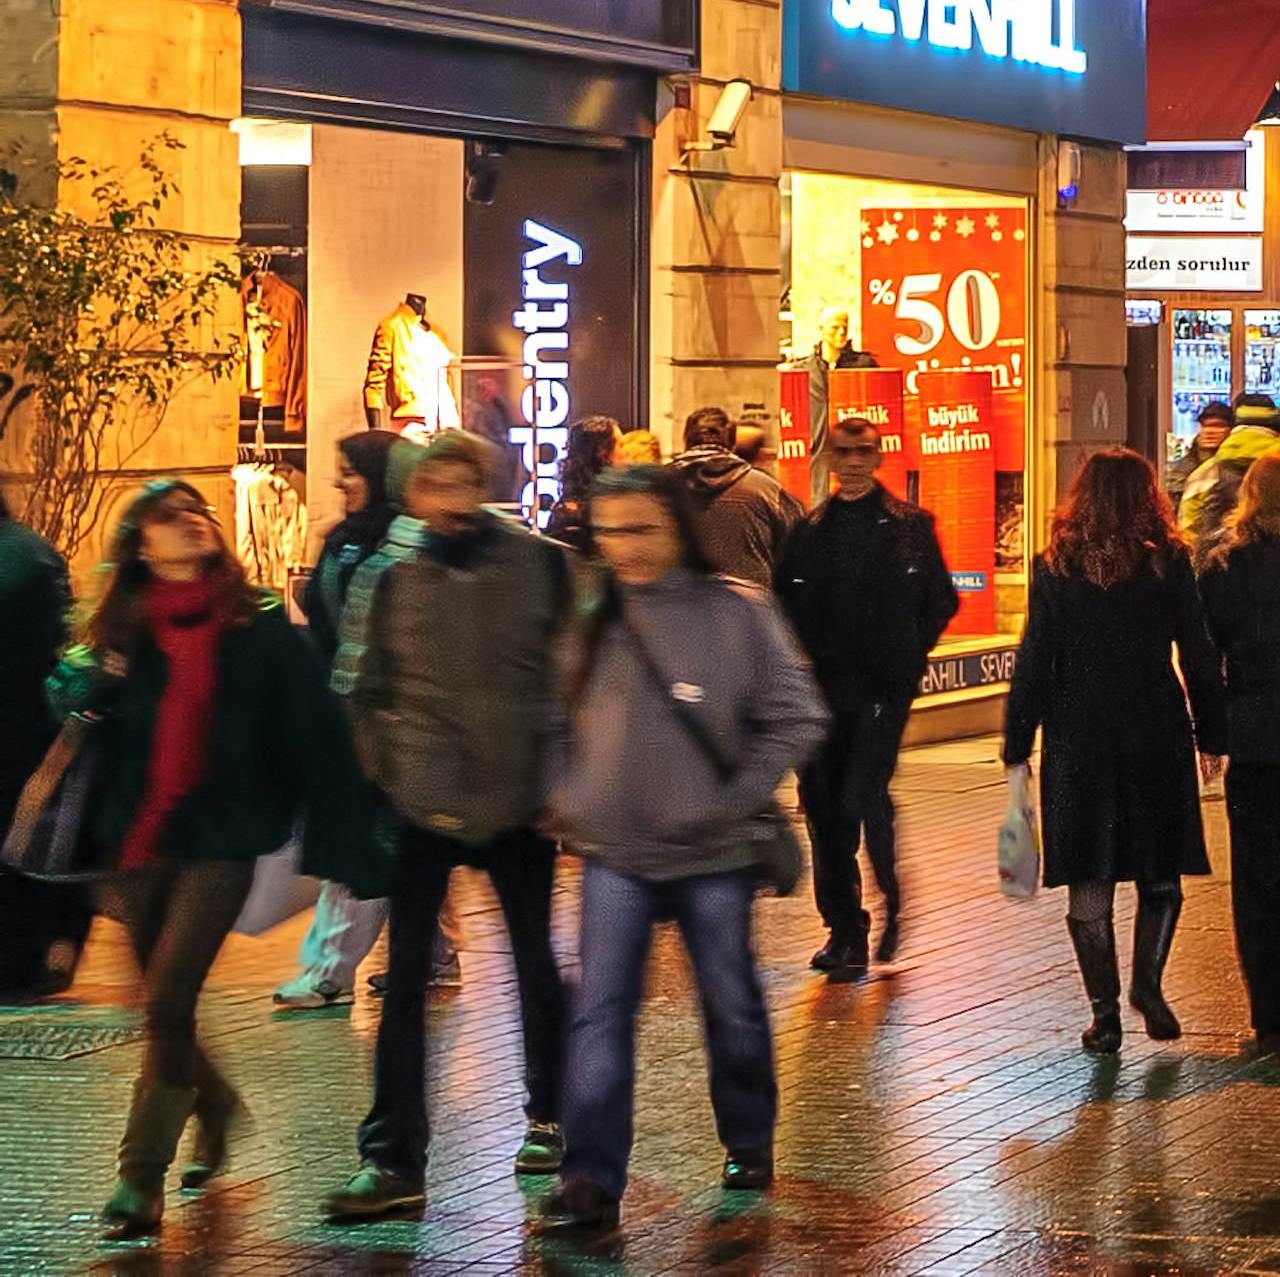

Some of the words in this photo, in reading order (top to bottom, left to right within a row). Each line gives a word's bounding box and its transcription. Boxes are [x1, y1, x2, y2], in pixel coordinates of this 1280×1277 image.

[1177, 257, 1250, 271] sorulur
[928, 404, 979, 434] büyük
[921, 430, 991, 455] indirim
